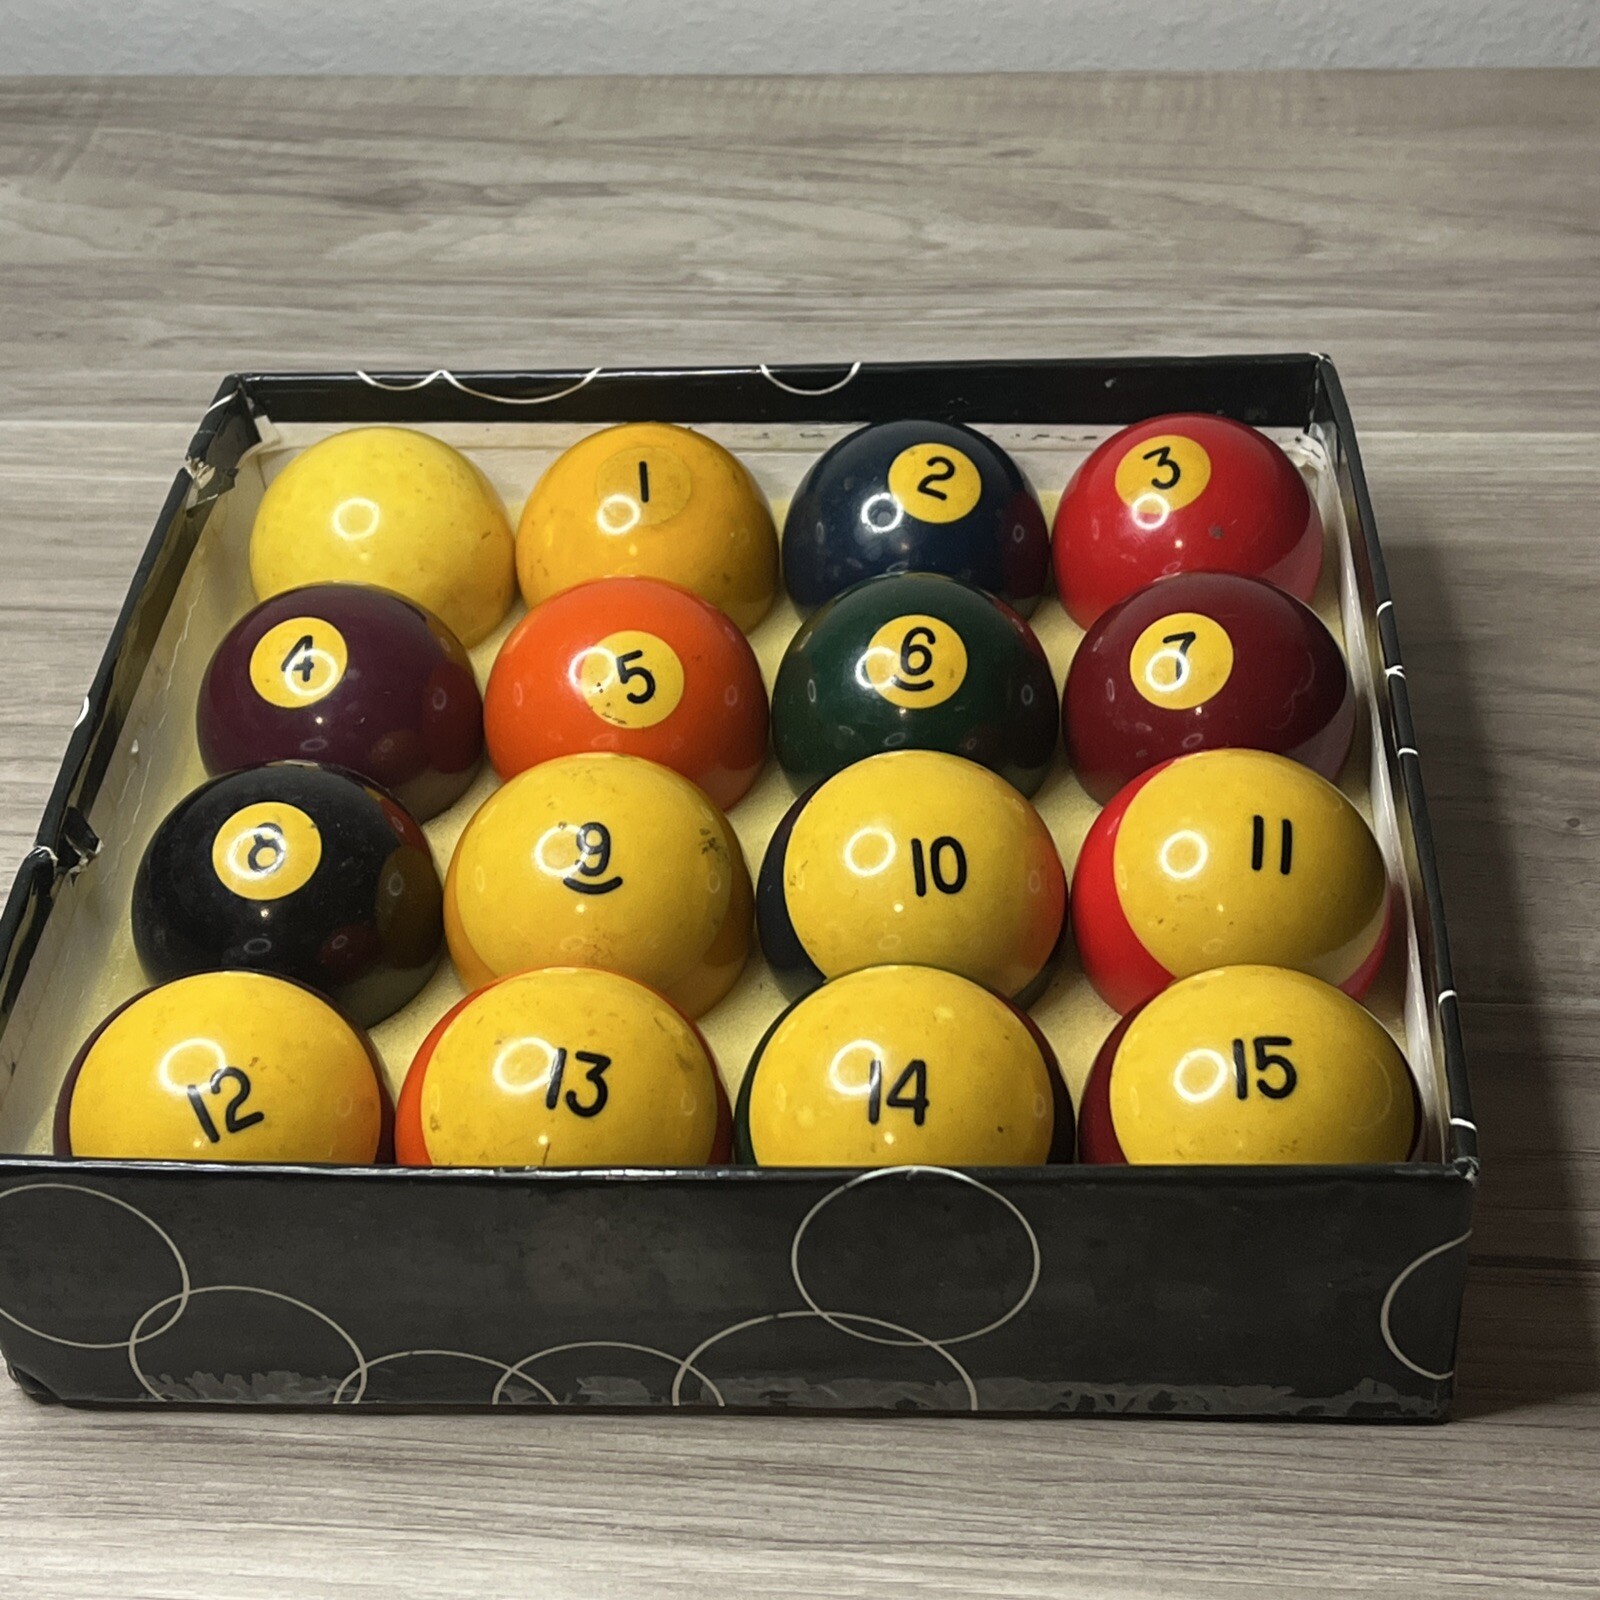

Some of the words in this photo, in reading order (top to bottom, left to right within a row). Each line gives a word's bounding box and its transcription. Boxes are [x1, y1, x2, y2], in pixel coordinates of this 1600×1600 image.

[638, 461, 650, 503] 1
[917, 456, 956, 501] 2
[1142, 446, 1181, 490] 3
[281, 635, 315, 682] 4
[617, 649, 656, 705] 5
[895, 626, 936, 689] 6
[1162, 631, 1196, 682] 7
[247, 822, 284, 873] 8
[910, 835, 968, 898] 10
[1251, 814, 1294, 876] 11
[545, 1047, 612, 1119] 13
[868, 1059, 930, 1127] 14
[1233, 1035, 1298, 1101] 15
[189, 1067, 265, 1144] 12
